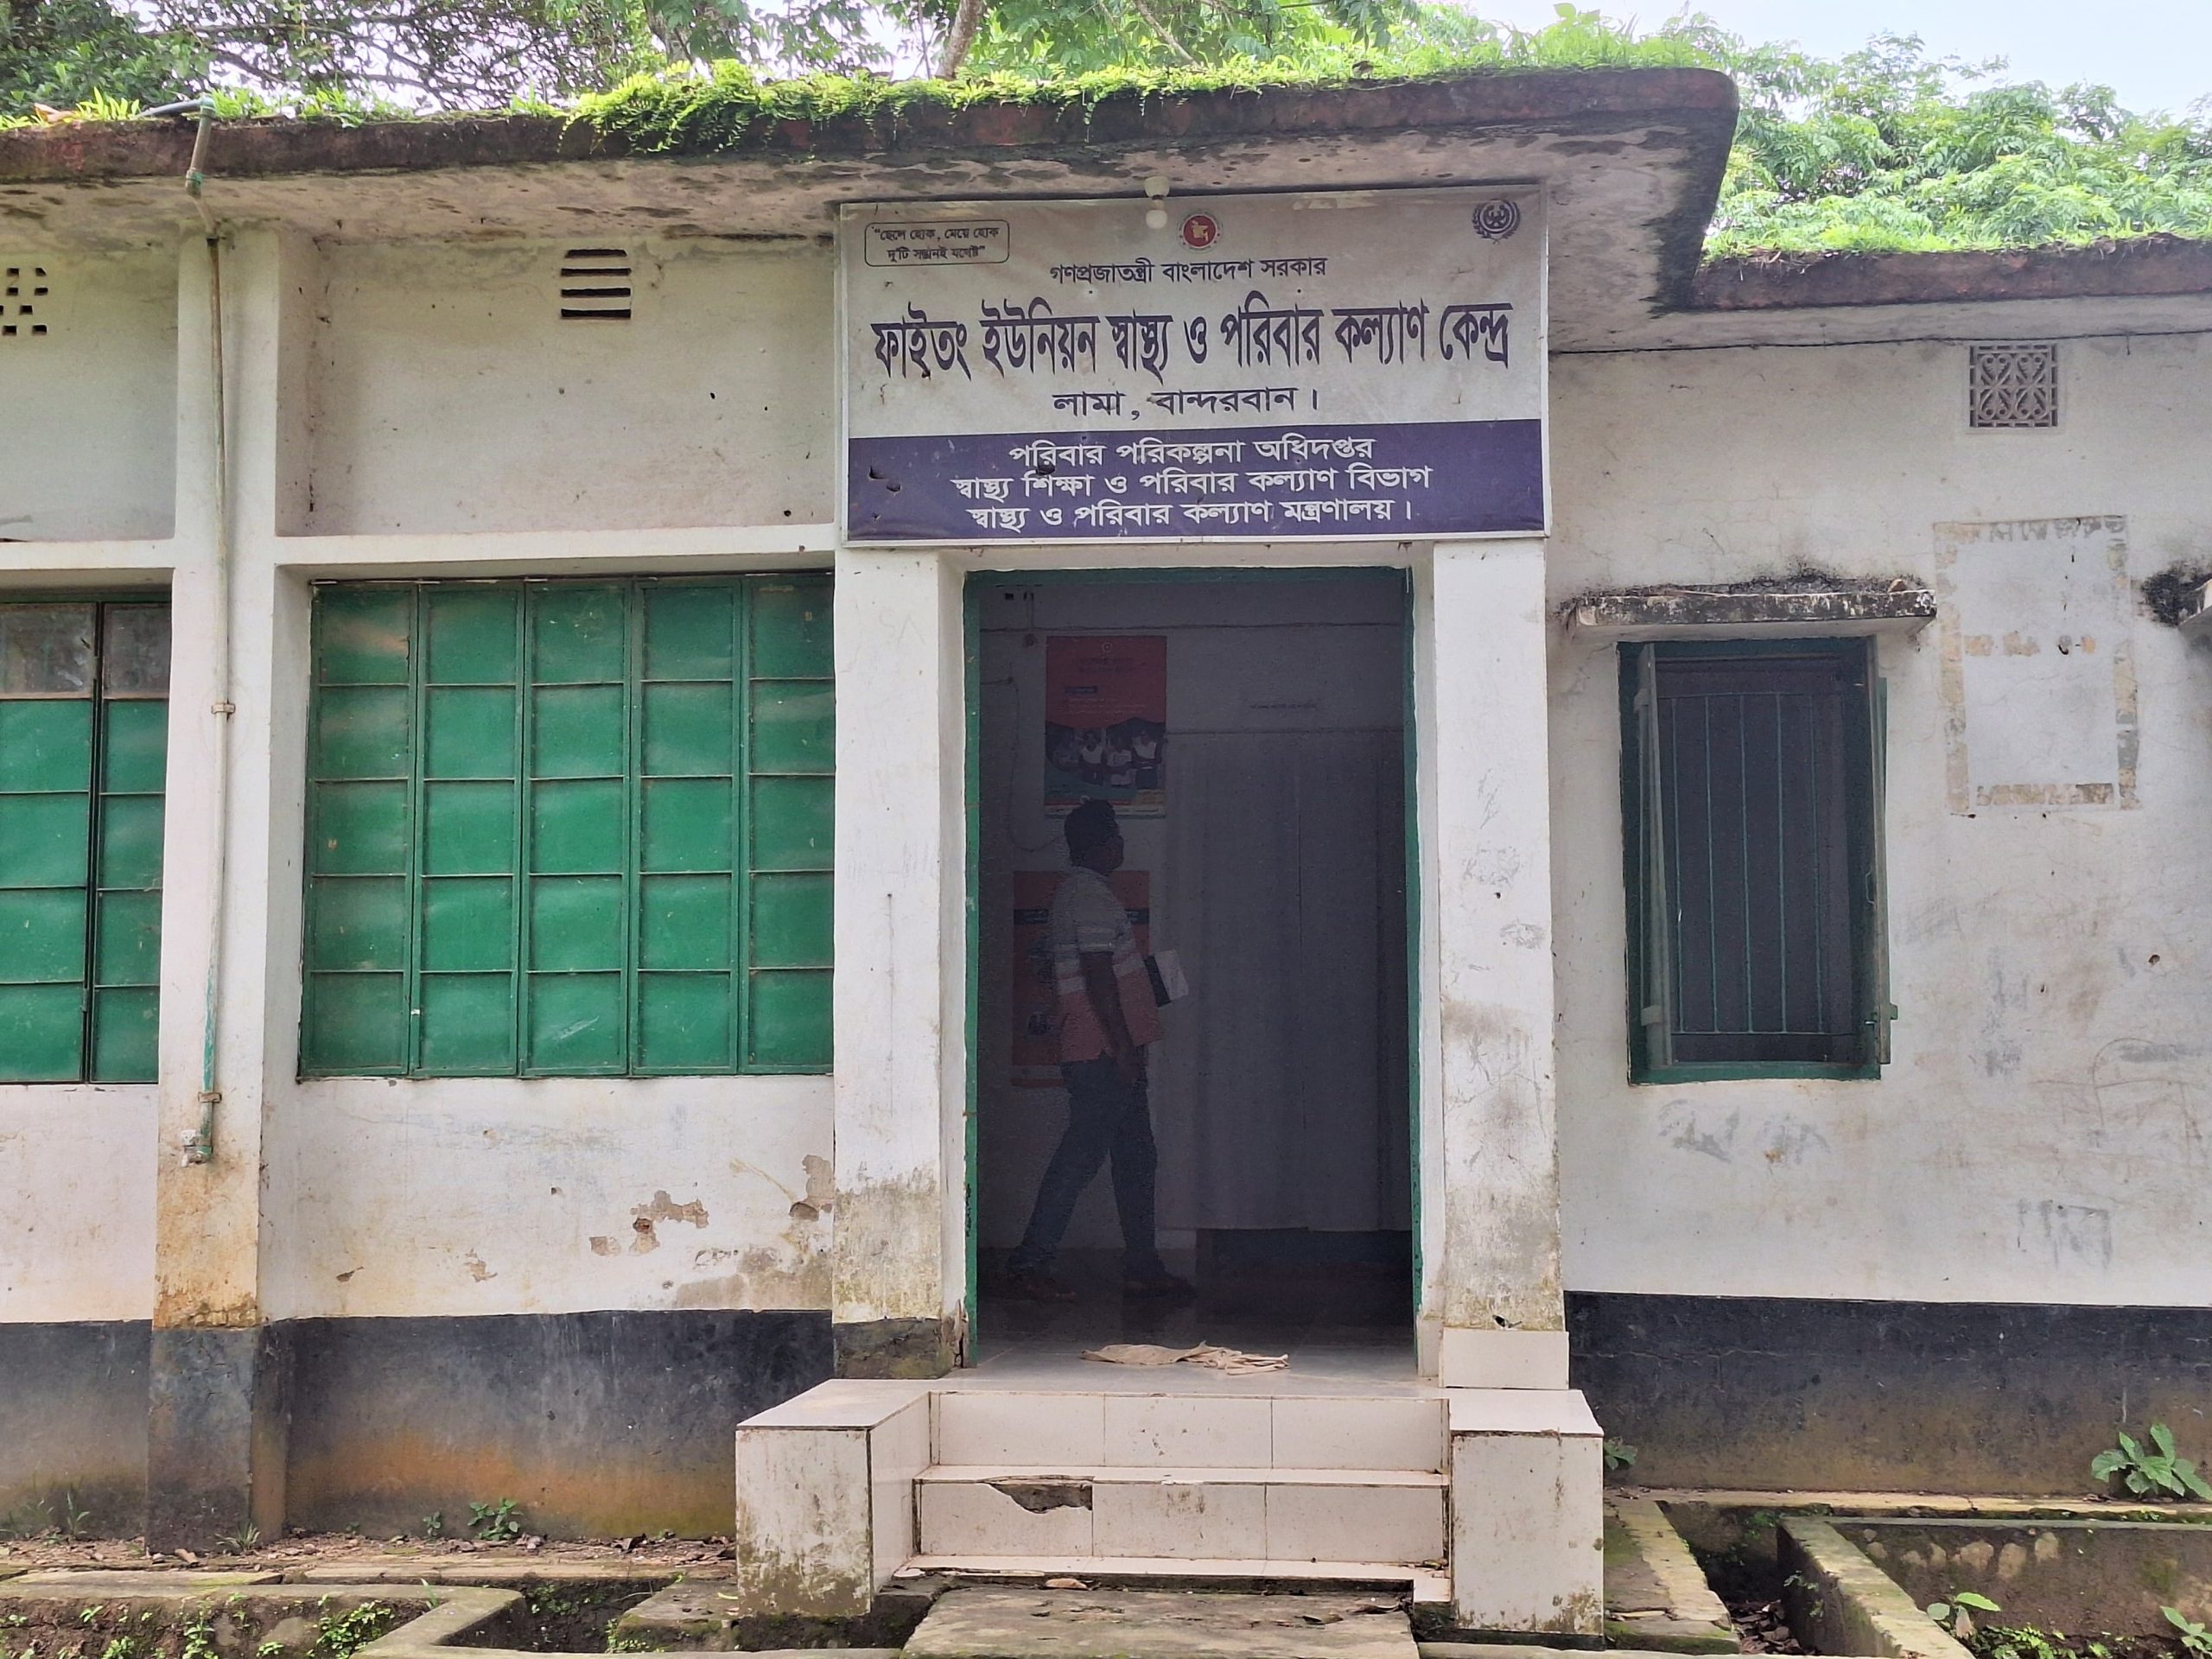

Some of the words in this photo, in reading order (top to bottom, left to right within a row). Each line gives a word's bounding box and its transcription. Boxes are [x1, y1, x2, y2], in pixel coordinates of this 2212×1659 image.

[1050, 257, 1155, 284] গণপ্রজাতন্ত্রী
[1161, 258, 1254, 283] বাংলাদেশ
[1260, 257, 1328, 278] সরকার
[870, 301, 972, 382] ফাইতং
[979, 296, 1101, 378] ইউনিয়ন
[1104, 308, 1174, 386] স্বাস্থ্য
[1184, 315, 1208, 365] ও
[1219, 289, 1325, 369] পরিবার
[1331, 297, 1430, 365] কল্যাণ
[1439, 302, 1514, 370] কেন্দ্র
[1008, 439, 1107, 467] পরিবার
[1116, 436, 1246, 466] পরিকল্পনা
[1252, 431, 1377, 461] অধিদপ্তর
[950, 477, 1014, 503] স্বাস্থ্য
[1020, 469, 1096, 498] শিক্ষা
[1104, 476, 1128, 494] ও
[1139, 467, 1239, 496] পরিবার
[1244, 467, 1339, 493] কল্যাণ
[1344, 461, 1434, 491] বিভাগ
[965, 506, 1032, 534] স্বাস্থ্য
[1039, 507, 1063, 526] ও
[1074, 499, 1174, 526] পরিবার
[1179, 499, 1274, 524] কল্যাণ
